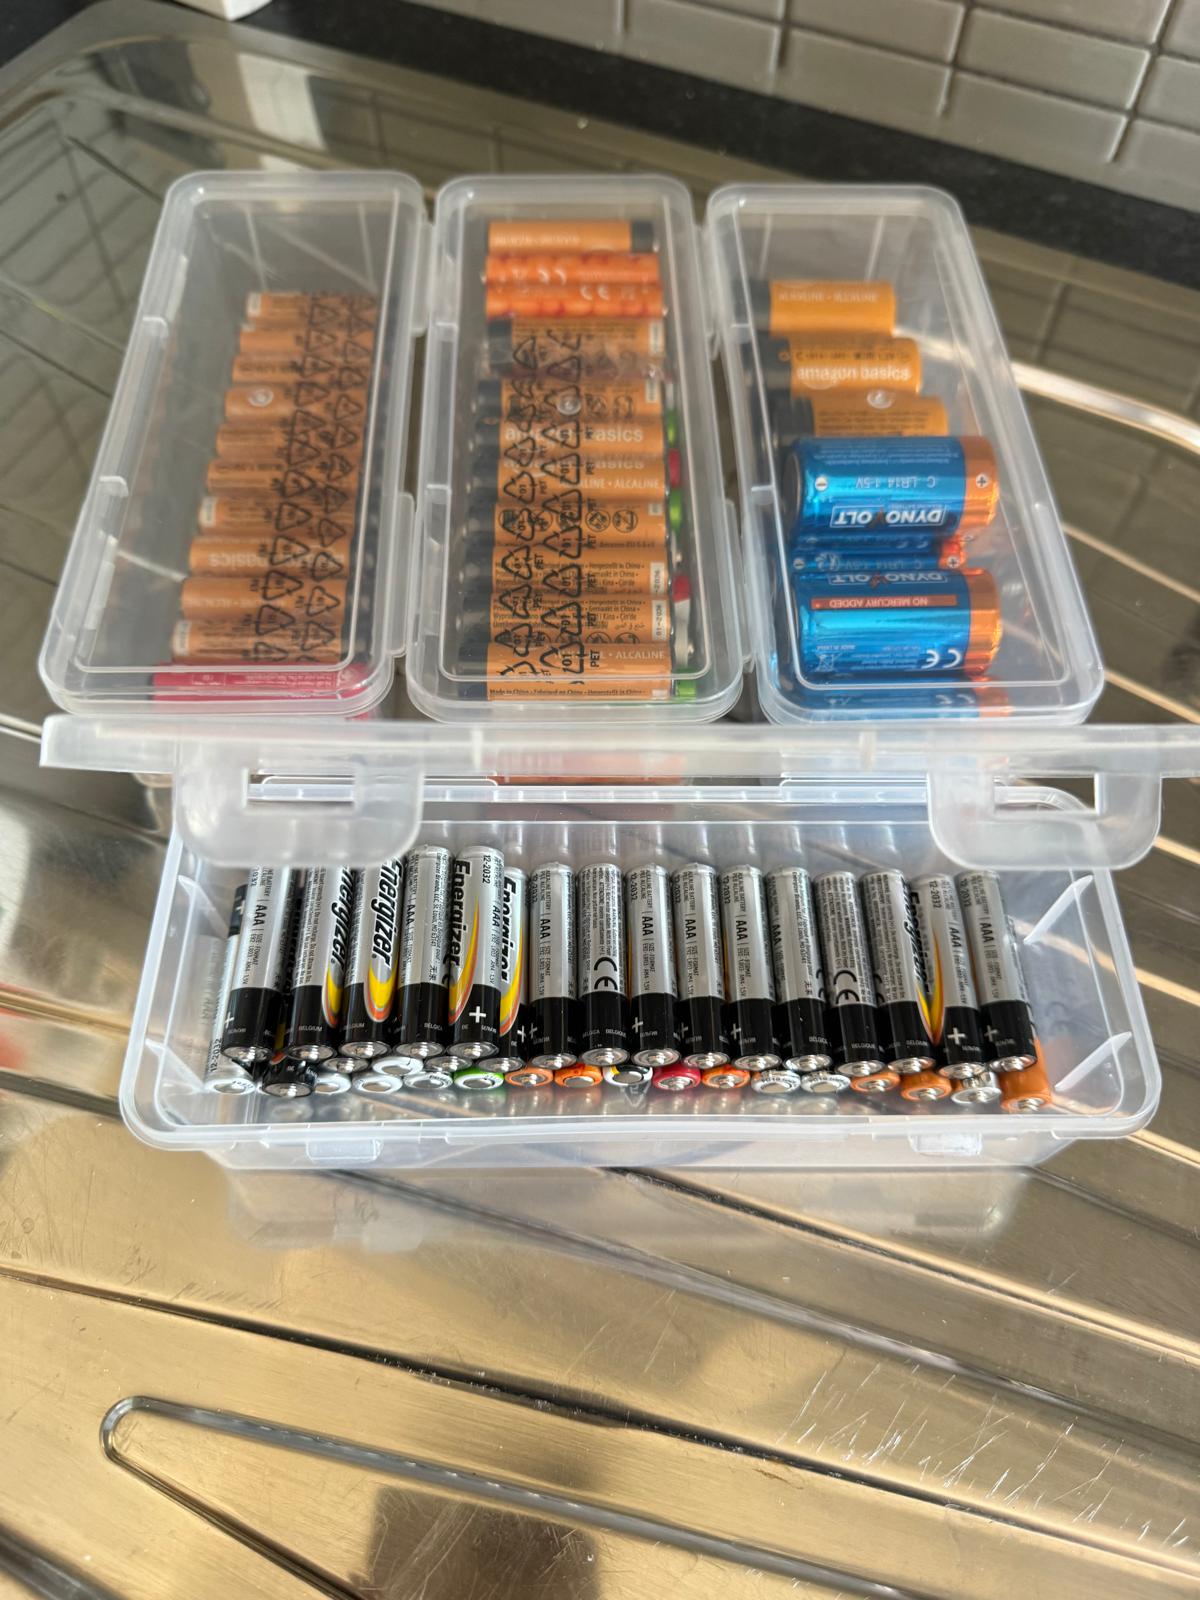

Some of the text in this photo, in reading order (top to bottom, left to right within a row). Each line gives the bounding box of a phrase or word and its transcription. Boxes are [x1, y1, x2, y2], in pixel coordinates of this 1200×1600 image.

[861, 366, 911, 380] basics
[829, 598, 928, 608] NO MERCURY ADDED
[590, 650, 600, 667] PET
[482, 855, 491, 883] 12-2032
[930, 881, 942, 908] 12-2032
[253, 905, 267, 926] AAA
[330, 864, 353, 969] nergizer
[371, 856, 402, 969] Energizer
[406, 904, 415, 926] AAA
[449, 860, 470, 966] Energizer
[492, 906, 500, 927] AAA
[540, 919, 551, 939] AAA
[642, 916, 653, 936] AAA
[685, 919, 697, 939] AAA
[736, 920, 748, 941] AAA
[772, 924, 782, 945] AAA
[980, 923, 994, 943] AAA
[949, 927, 961, 947] AAA
[210, 1038, 222, 1072] 12-2032
